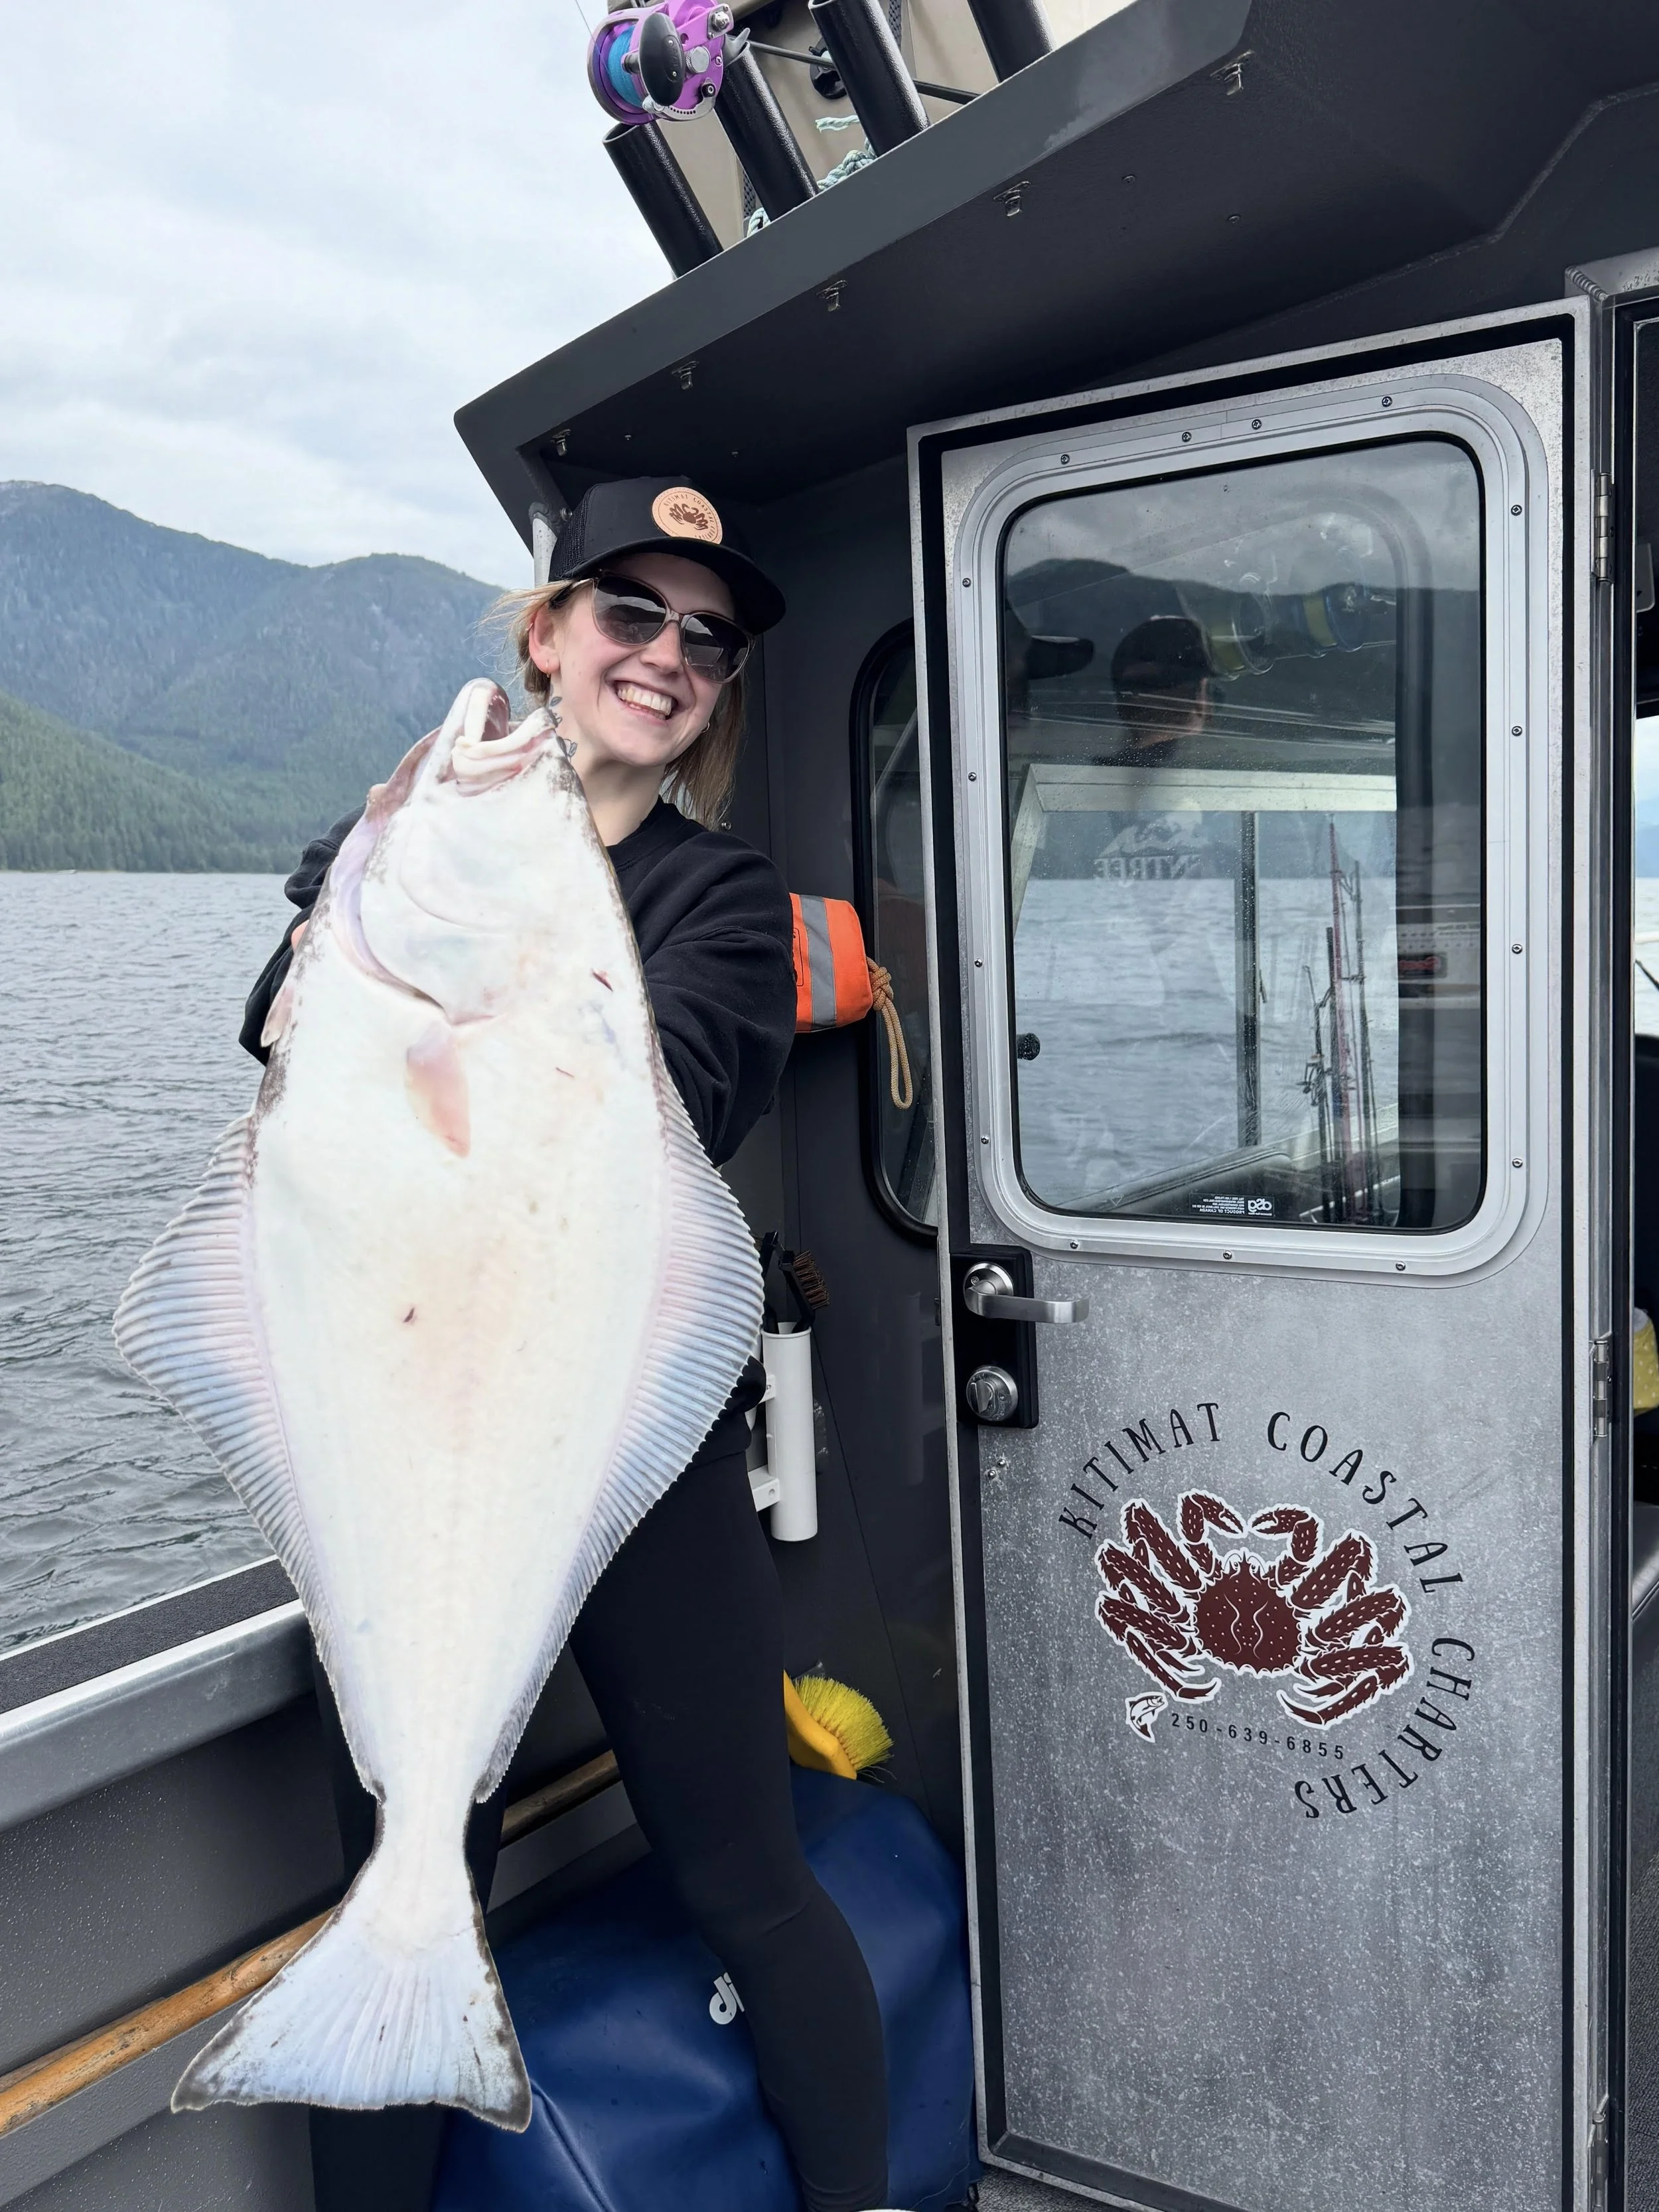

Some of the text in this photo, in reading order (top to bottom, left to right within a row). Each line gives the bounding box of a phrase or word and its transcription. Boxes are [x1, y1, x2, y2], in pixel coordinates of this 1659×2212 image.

[1058, 1403, 1475, 1819] KITIMAT COASTAL CHARTERS
[1171, 1713, 1344, 1760] 250-639-6855
